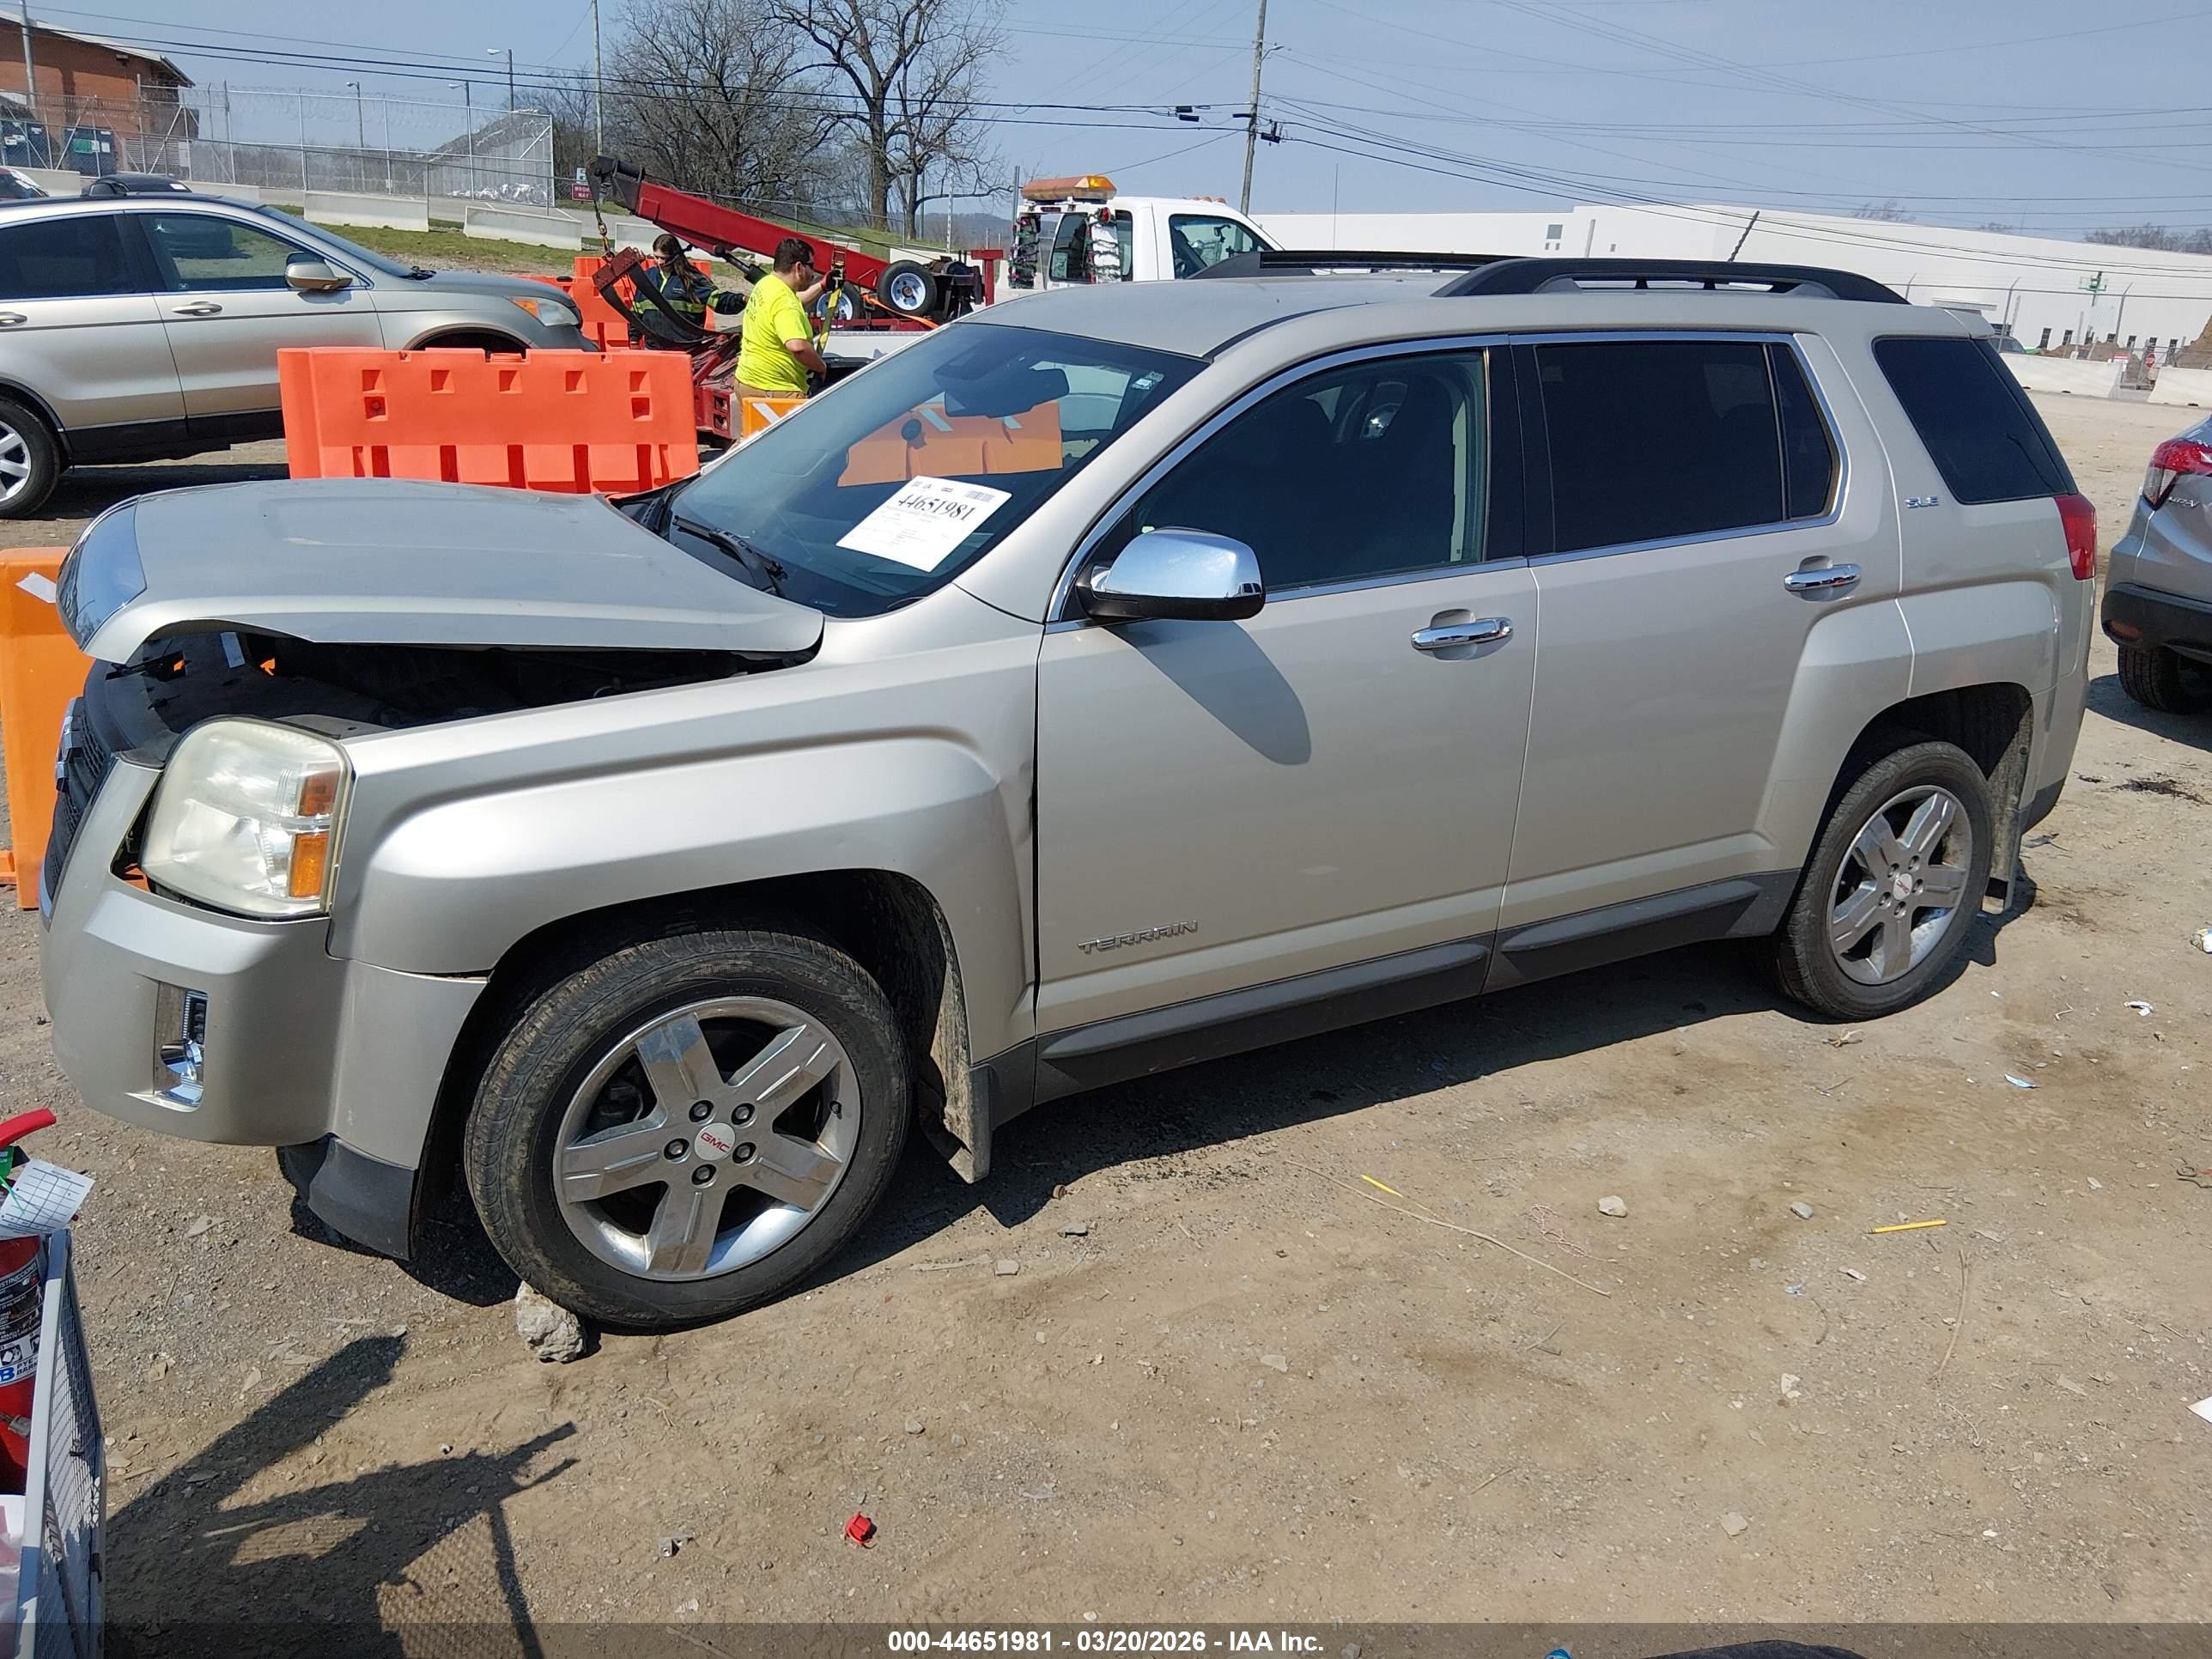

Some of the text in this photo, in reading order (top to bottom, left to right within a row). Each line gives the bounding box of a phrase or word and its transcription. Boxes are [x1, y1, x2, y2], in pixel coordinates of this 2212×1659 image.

[897, 494, 977, 521] 44651981
[1904, 495, 1939, 508] SLE
[1078, 920, 1198, 954] TERRAIN
[700, 1131, 731, 1154] GMC
